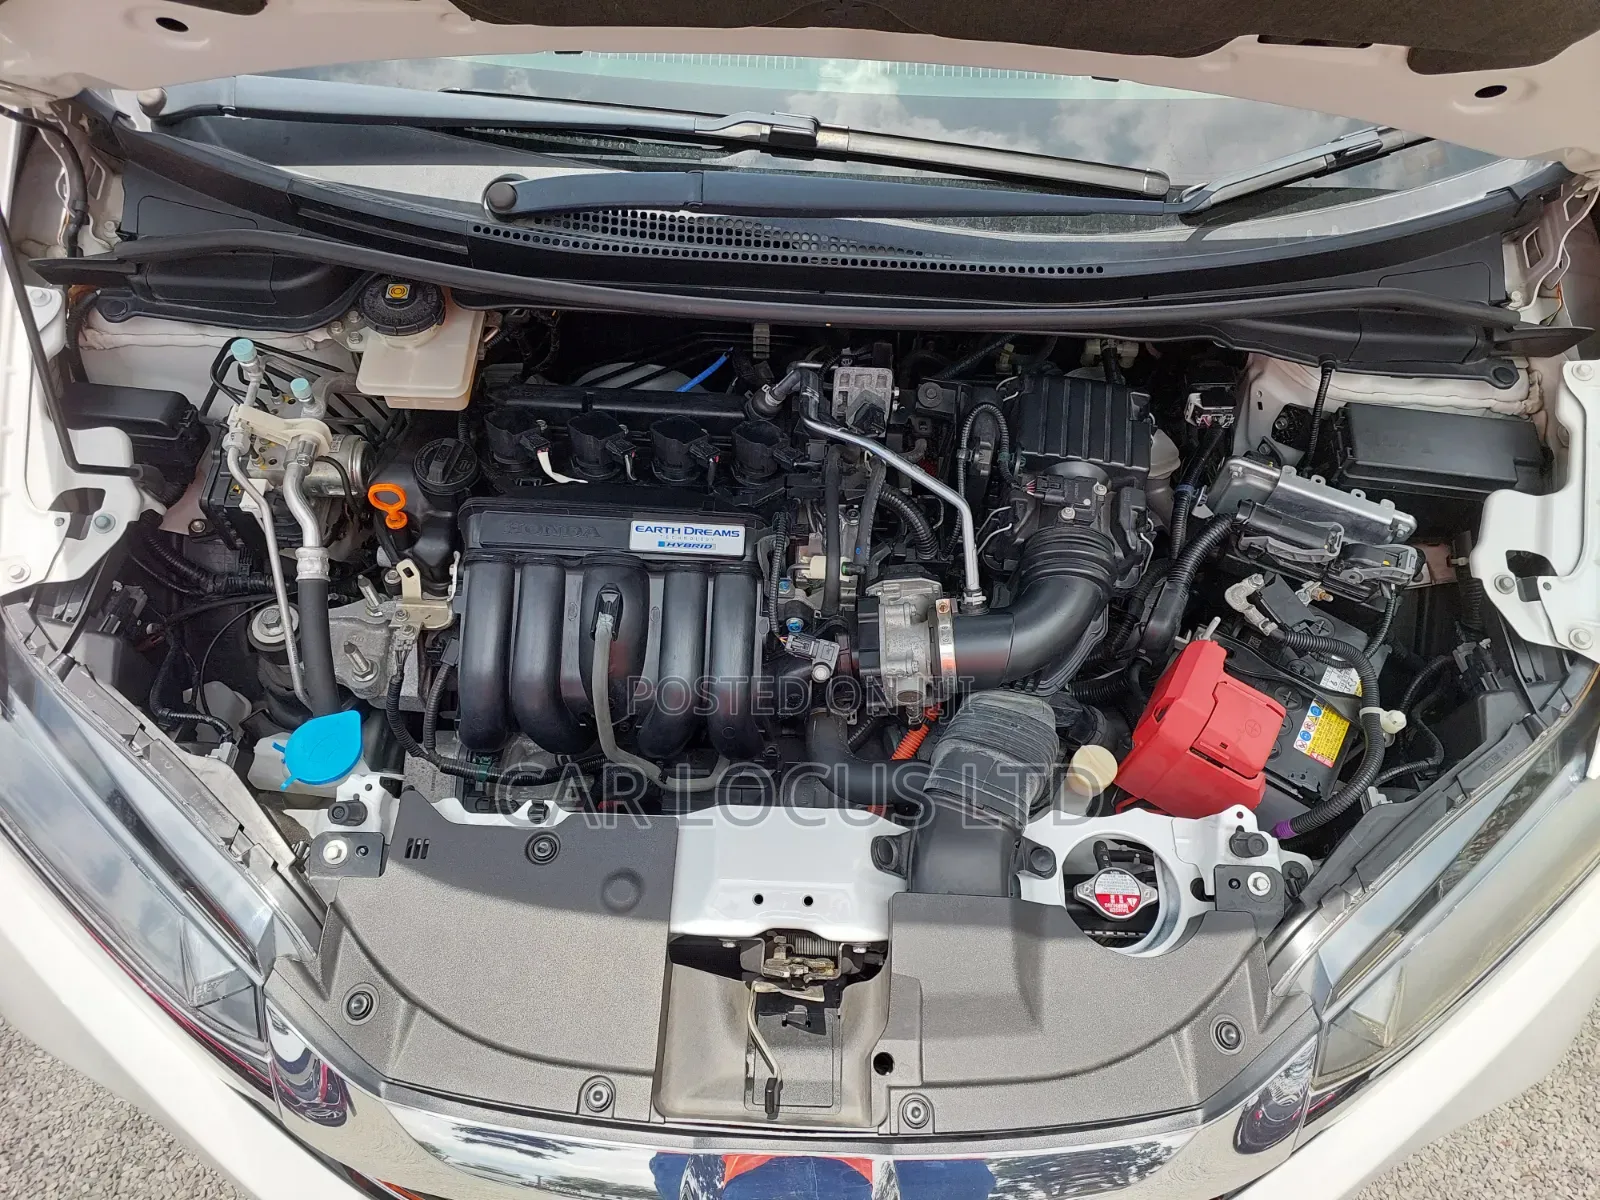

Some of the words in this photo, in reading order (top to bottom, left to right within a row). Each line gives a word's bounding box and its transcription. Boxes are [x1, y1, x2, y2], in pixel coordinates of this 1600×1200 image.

[502, 520, 603, 539] HONDA
[635, 525, 681, 535] EARTH
[684, 526, 740, 538] DREAMS
